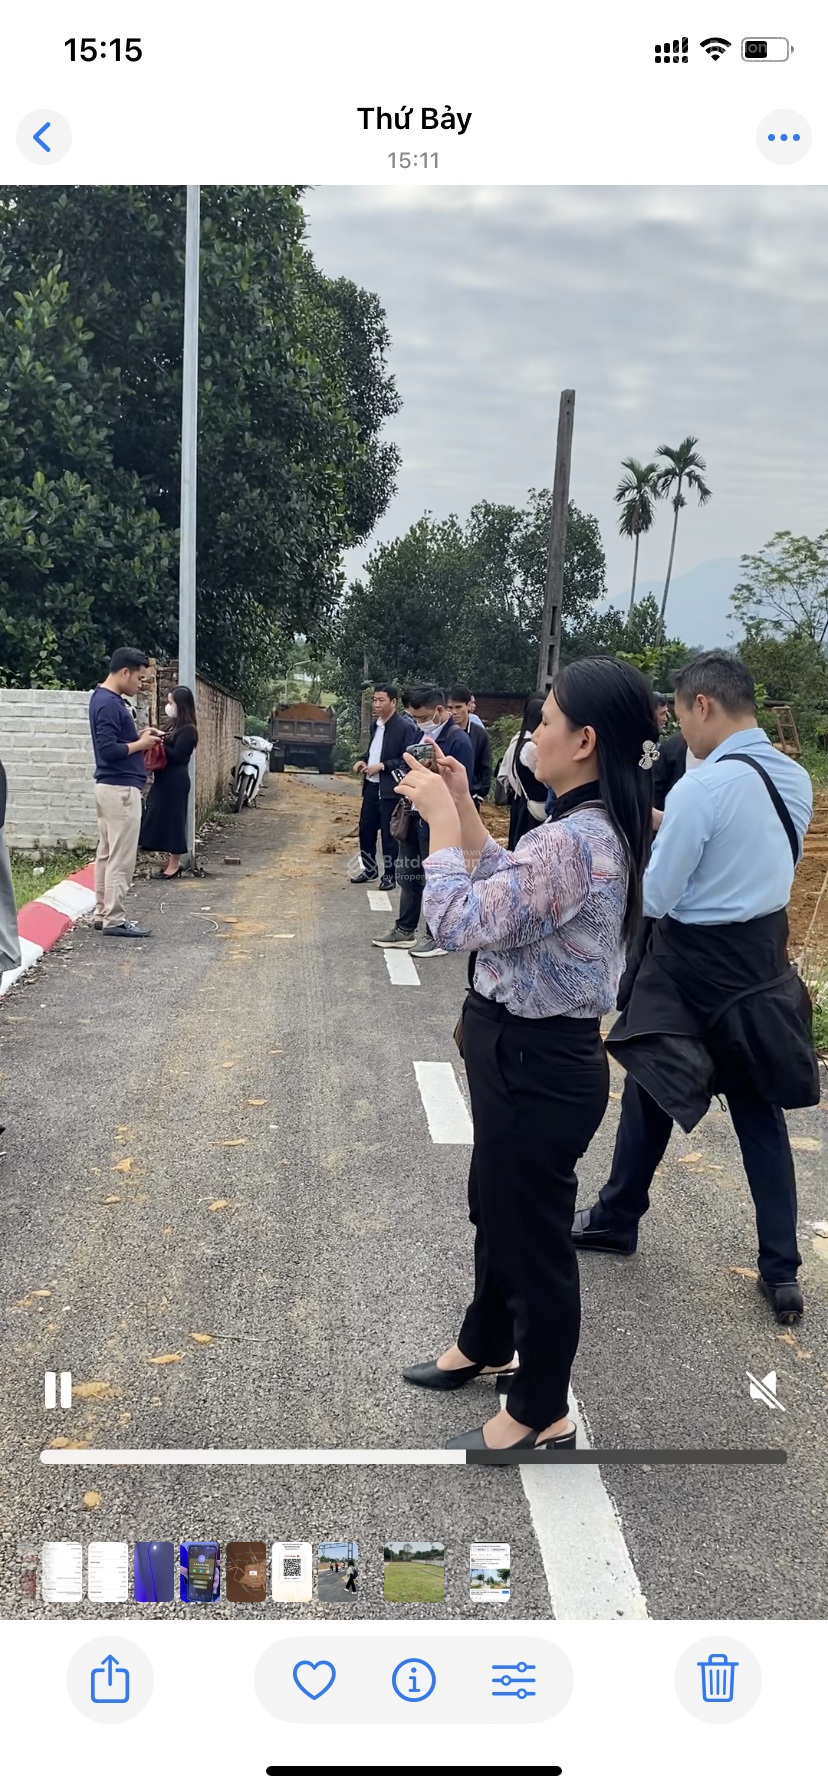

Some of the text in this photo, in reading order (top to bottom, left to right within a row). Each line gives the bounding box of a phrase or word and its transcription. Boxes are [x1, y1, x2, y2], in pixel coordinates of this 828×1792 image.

[64, 37, 143, 63] 15:15
[356, 104, 473, 136] Thứ Bảy
[387, 151, 439, 169] 15:11
